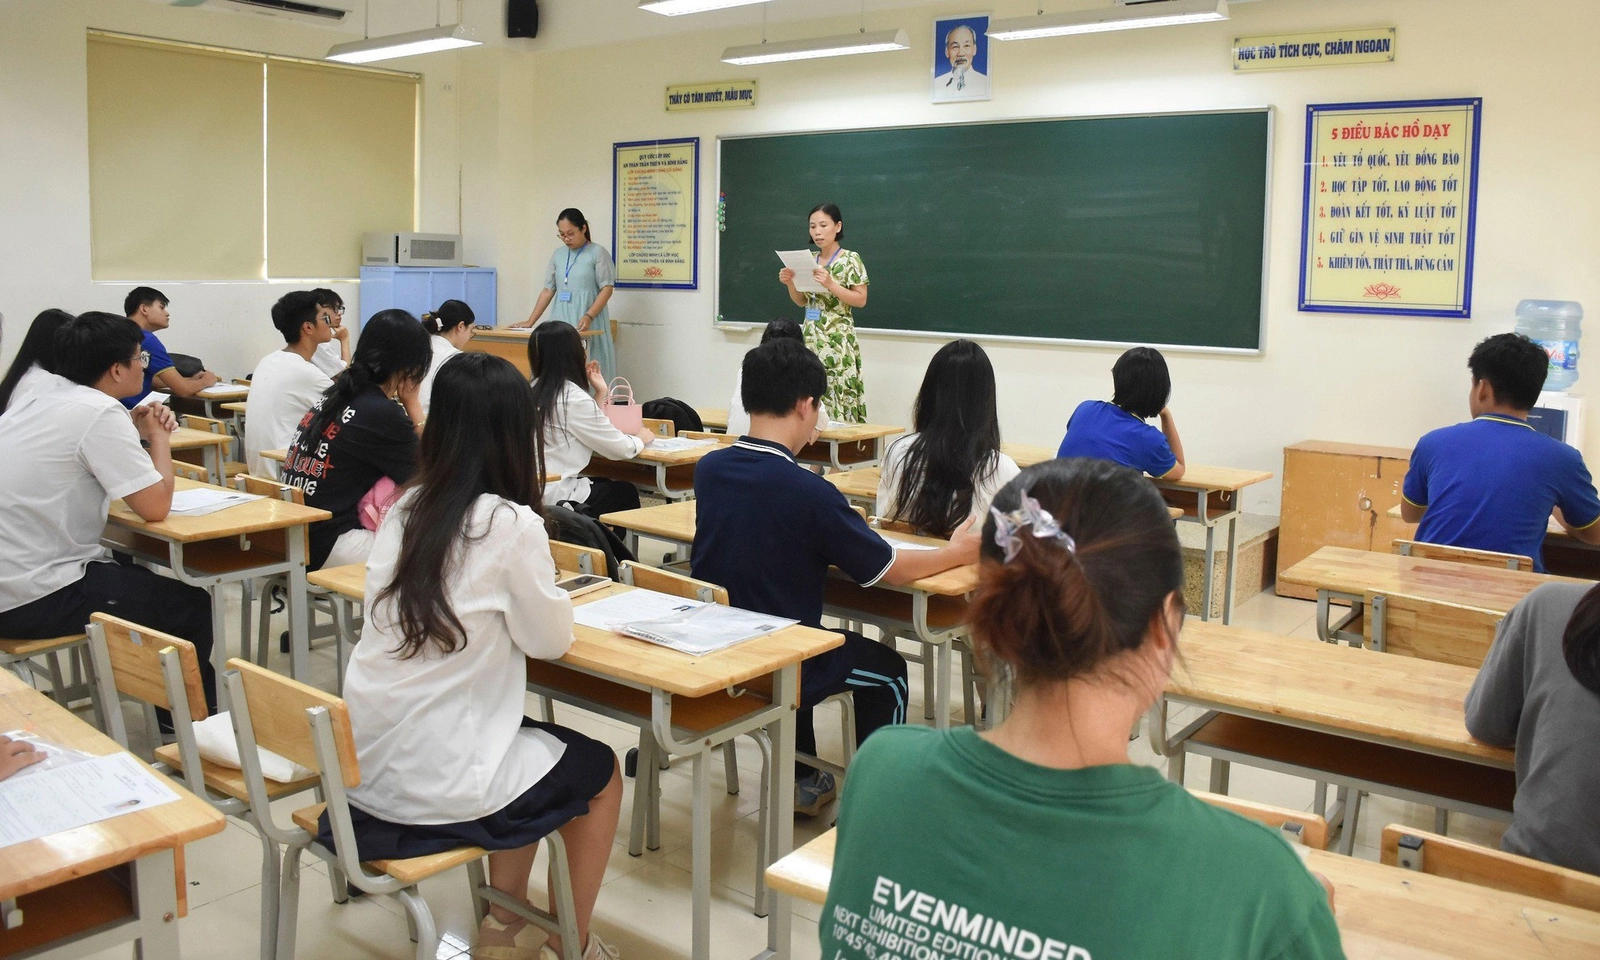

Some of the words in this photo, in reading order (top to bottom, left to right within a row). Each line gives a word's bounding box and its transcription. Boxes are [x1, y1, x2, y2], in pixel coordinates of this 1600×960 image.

[1238, 46, 1255, 62] HỌC
[1258, 43, 1276, 59] TRÒ
[1279, 42, 1299, 58] TÍCH
[1302, 42, 1322, 59] CỰC,
[1325, 39, 1352, 55] CHĂM
[1356, 39, 1390, 54] NGOAN
[1332, 128, 1338, 140] 5
[1342, 121, 1371, 139] ĐIỀU
[1374, 123, 1399, 139] BÁC
[1402, 119, 1419, 138] HỒ
[1423, 124, 1450, 140] DẠY
[1333, 152, 1348, 167] YÊU
[1396, 151, 1410, 166] YÊU
[1416, 148, 1436, 165] ĐỒNG
[1321, 181, 1327, 192] 2.
[1332, 181, 1347, 196] HỌC
[1352, 177, 1367, 196] TẬP
[1395, 181, 1410, 192] LAO
[1415, 176, 1436, 196] ĐỘNG
[1442, 174, 1458, 191] TỐT
[1319, 206, 1325, 218] 3.
[1331, 203, 1350, 218] ĐOÀN
[1356, 200, 1371, 218] KẾT
[1398, 201, 1410, 218] KỶ
[1415, 203, 1435, 222] LUẬT
[1441, 200, 1456, 218] TỐT
[1319, 232, 1325, 243] 4.
[1330, 228, 1345, 243] GIỮ
[1350, 228, 1363, 243] GÌN
[1370, 229, 1379, 247] VỆ
[1384, 232, 1404, 244] SINH
[1410, 229, 1432, 248] THẬT
[1438, 227, 1455, 244] TỐT
[1329, 254, 1352, 269] KHIÊM
[1373, 255, 1393, 273] THẬT
[1415, 255, 1434, 271] DŨNG
[1437, 254, 1453, 271] CẢM
[833, 904, 861, 929] NEXT
[860, 918, 946, 960] EXHIBITION
[868, 904, 930, 942] LIMITED
